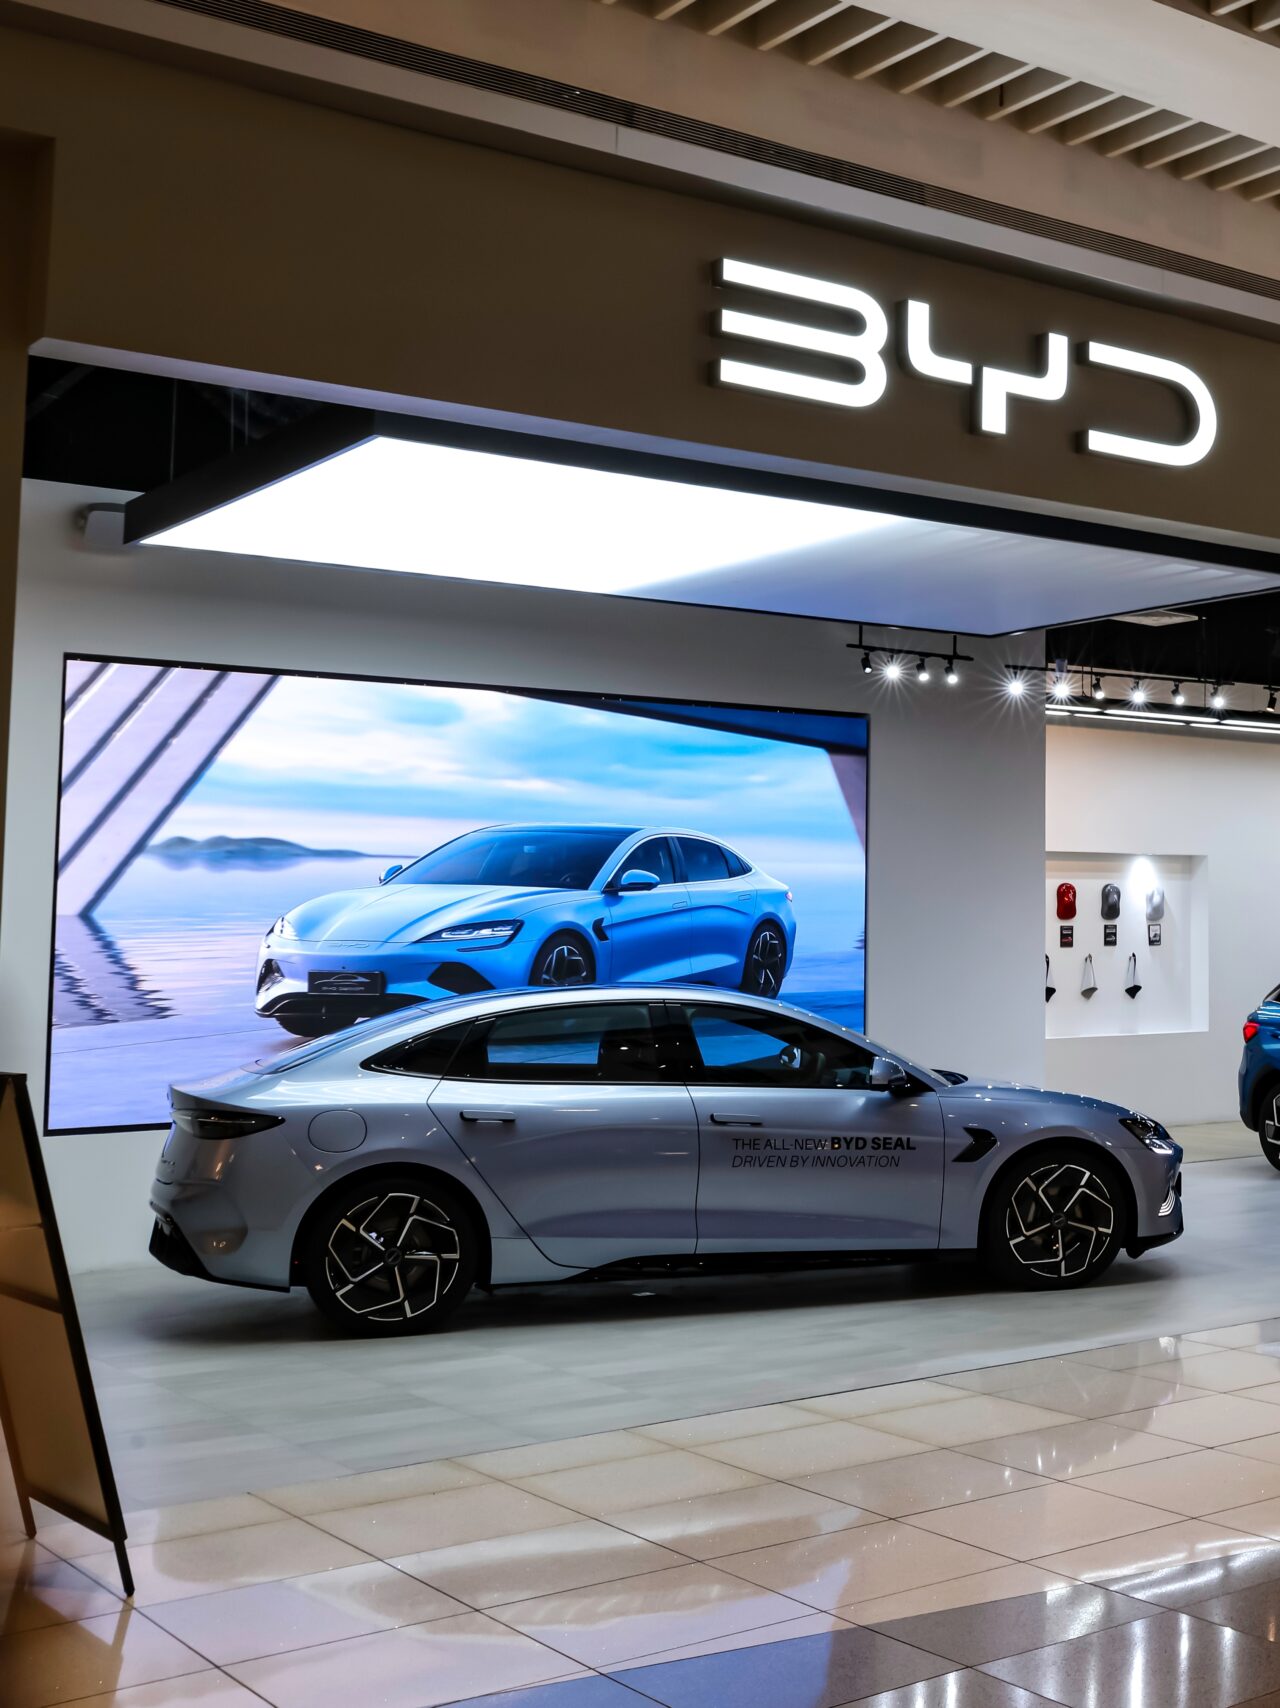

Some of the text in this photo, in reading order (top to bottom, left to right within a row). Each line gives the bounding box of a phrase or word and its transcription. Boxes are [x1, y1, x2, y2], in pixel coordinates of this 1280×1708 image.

[717, 257, 1218, 467] BYD
[732, 1136, 916, 1151] THE ALL-NEW BYD SEAL
[731, 1155, 901, 1168] DRIVEN BY INNOVATION
